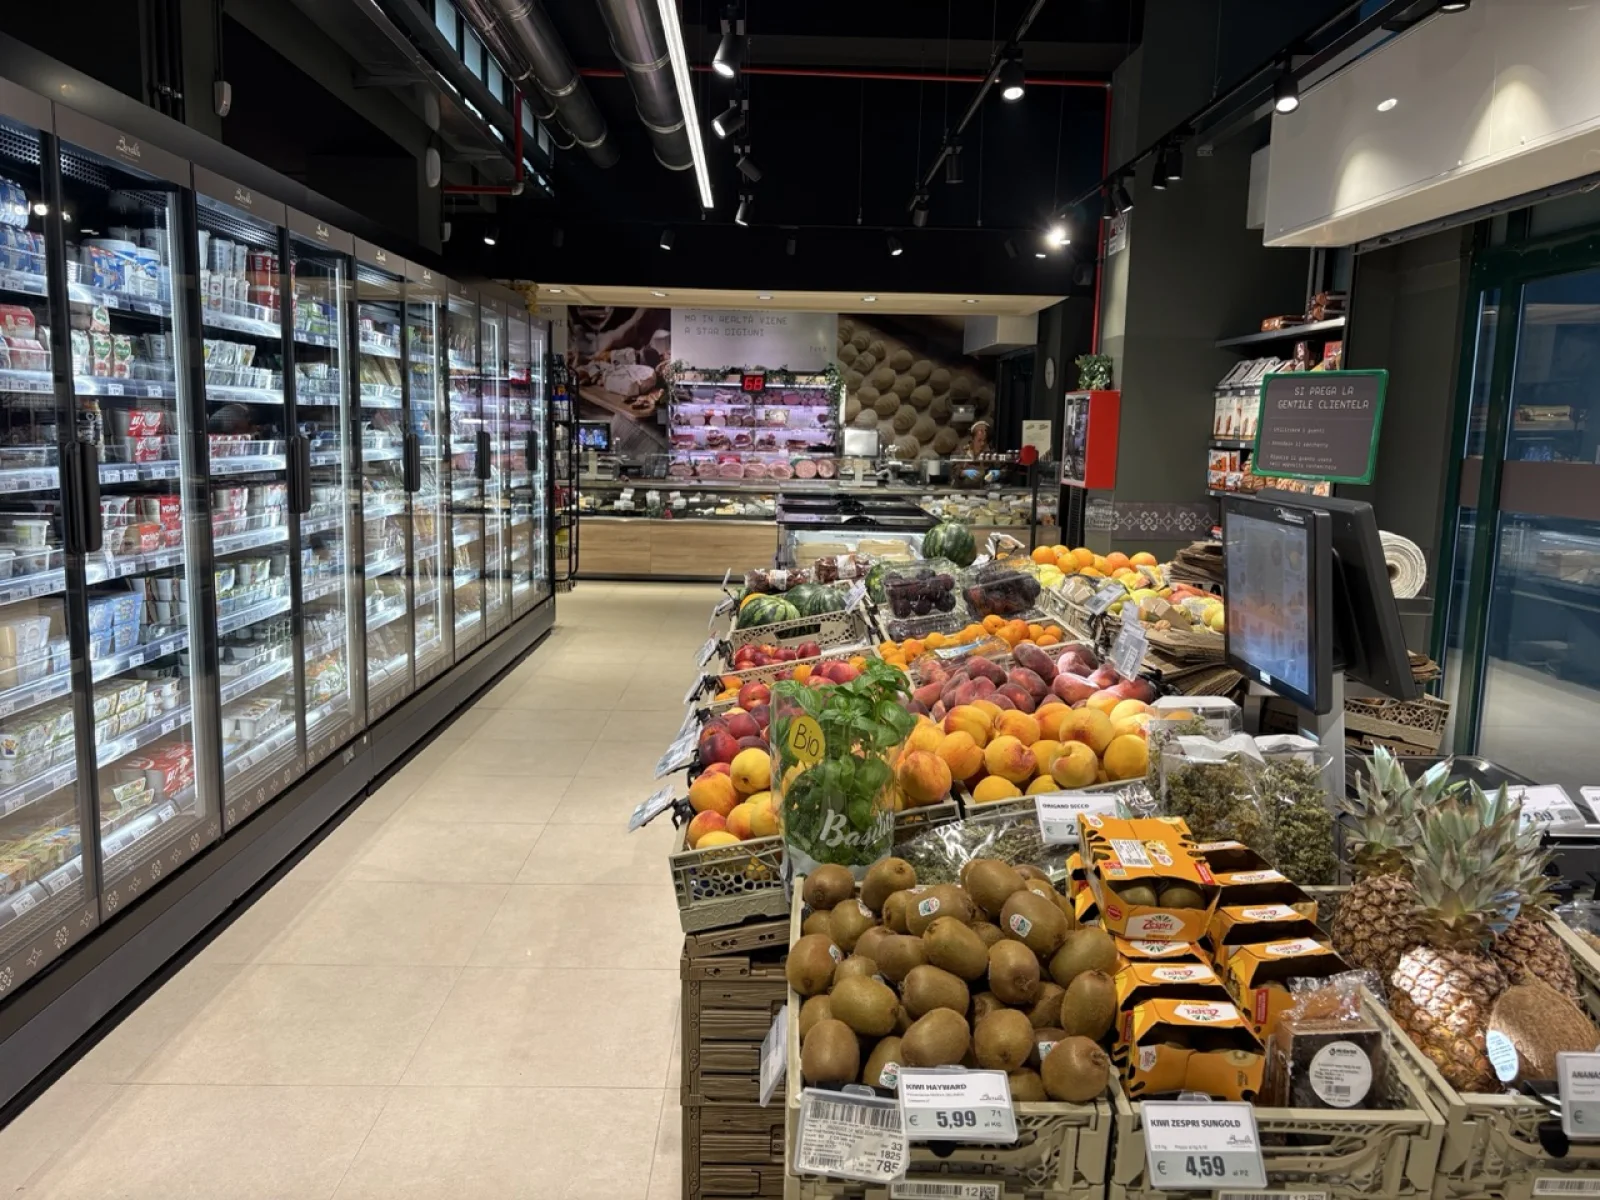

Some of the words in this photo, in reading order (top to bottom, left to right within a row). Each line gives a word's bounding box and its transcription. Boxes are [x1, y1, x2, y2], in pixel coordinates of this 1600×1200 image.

[684, 314, 697, 322] MA
[702, 314, 713, 323] IN
[760, 316, 788, 325] VIENE
[684, 326, 691, 335] A
[696, 327, 720, 336] STAR
[725, 328, 765, 337] DIGIUNI
[744, 376, 763, 391] 68
[1294, 387, 1305, 396] SI
[1309, 386, 1337, 396] PREGA
[1341, 385, 1354, 396] LA
[1277, 400, 1313, 410] GENTILE
[1318, 399, 1369, 410] CLIENTELA
[793, 723, 820, 757] Bio
[1142, 919, 1174, 930] Zespri
[926, 1083, 967, 1091] HAYWARD
[990, 1109, 1002, 1117] 71
[1574, 1109, 1585, 1125] €
[909, 1114, 919, 1126] €
[936, 1110, 977, 1130] 5,99
[1150, 1119, 1170, 1128] KIWI
[1171, 1119, 1200, 1128] ZESPRI
[1201, 1119, 1241, 1129] SUNGOLD
[890, 1142, 903, 1151] 33
[880, 1150, 901, 1160] 1825
[1157, 1160, 1168, 1175] €
[1185, 1155, 1226, 1179] 4,59
[965, 1186, 979, 1196] 12
